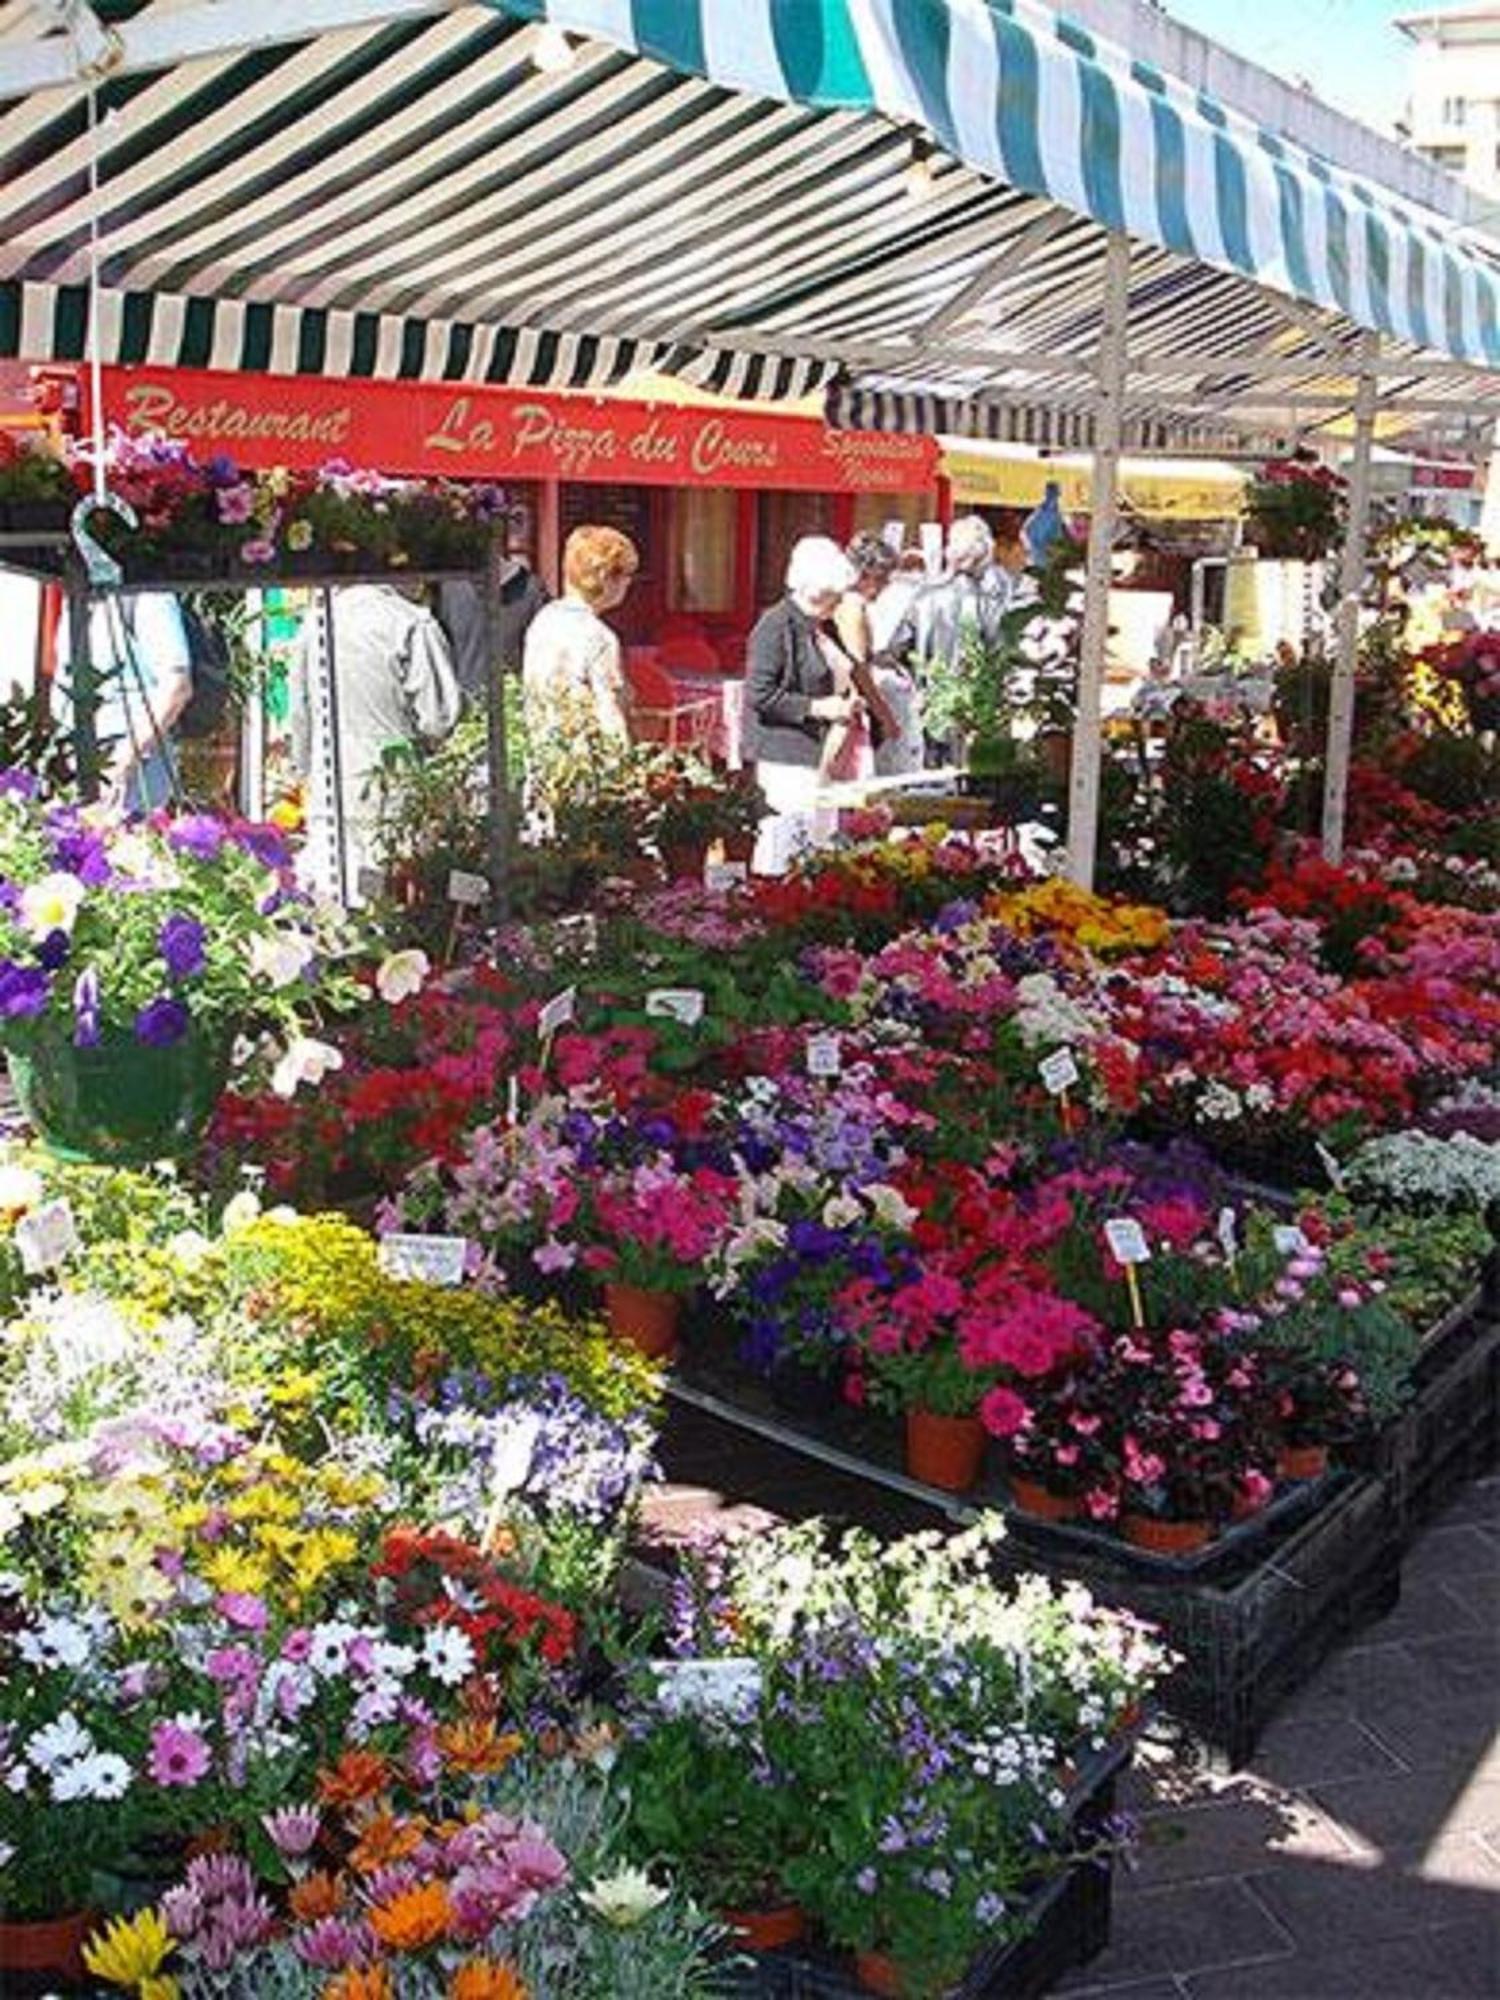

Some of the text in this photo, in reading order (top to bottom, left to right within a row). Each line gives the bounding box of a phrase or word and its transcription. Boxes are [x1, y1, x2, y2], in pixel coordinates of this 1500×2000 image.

[125, 384, 351, 444] Restaurant
[424, 397, 495, 453] La
[511, 404, 614, 475] Pizza
[629, 418, 678, 463] du
[690, 418, 779, 475] Cours
